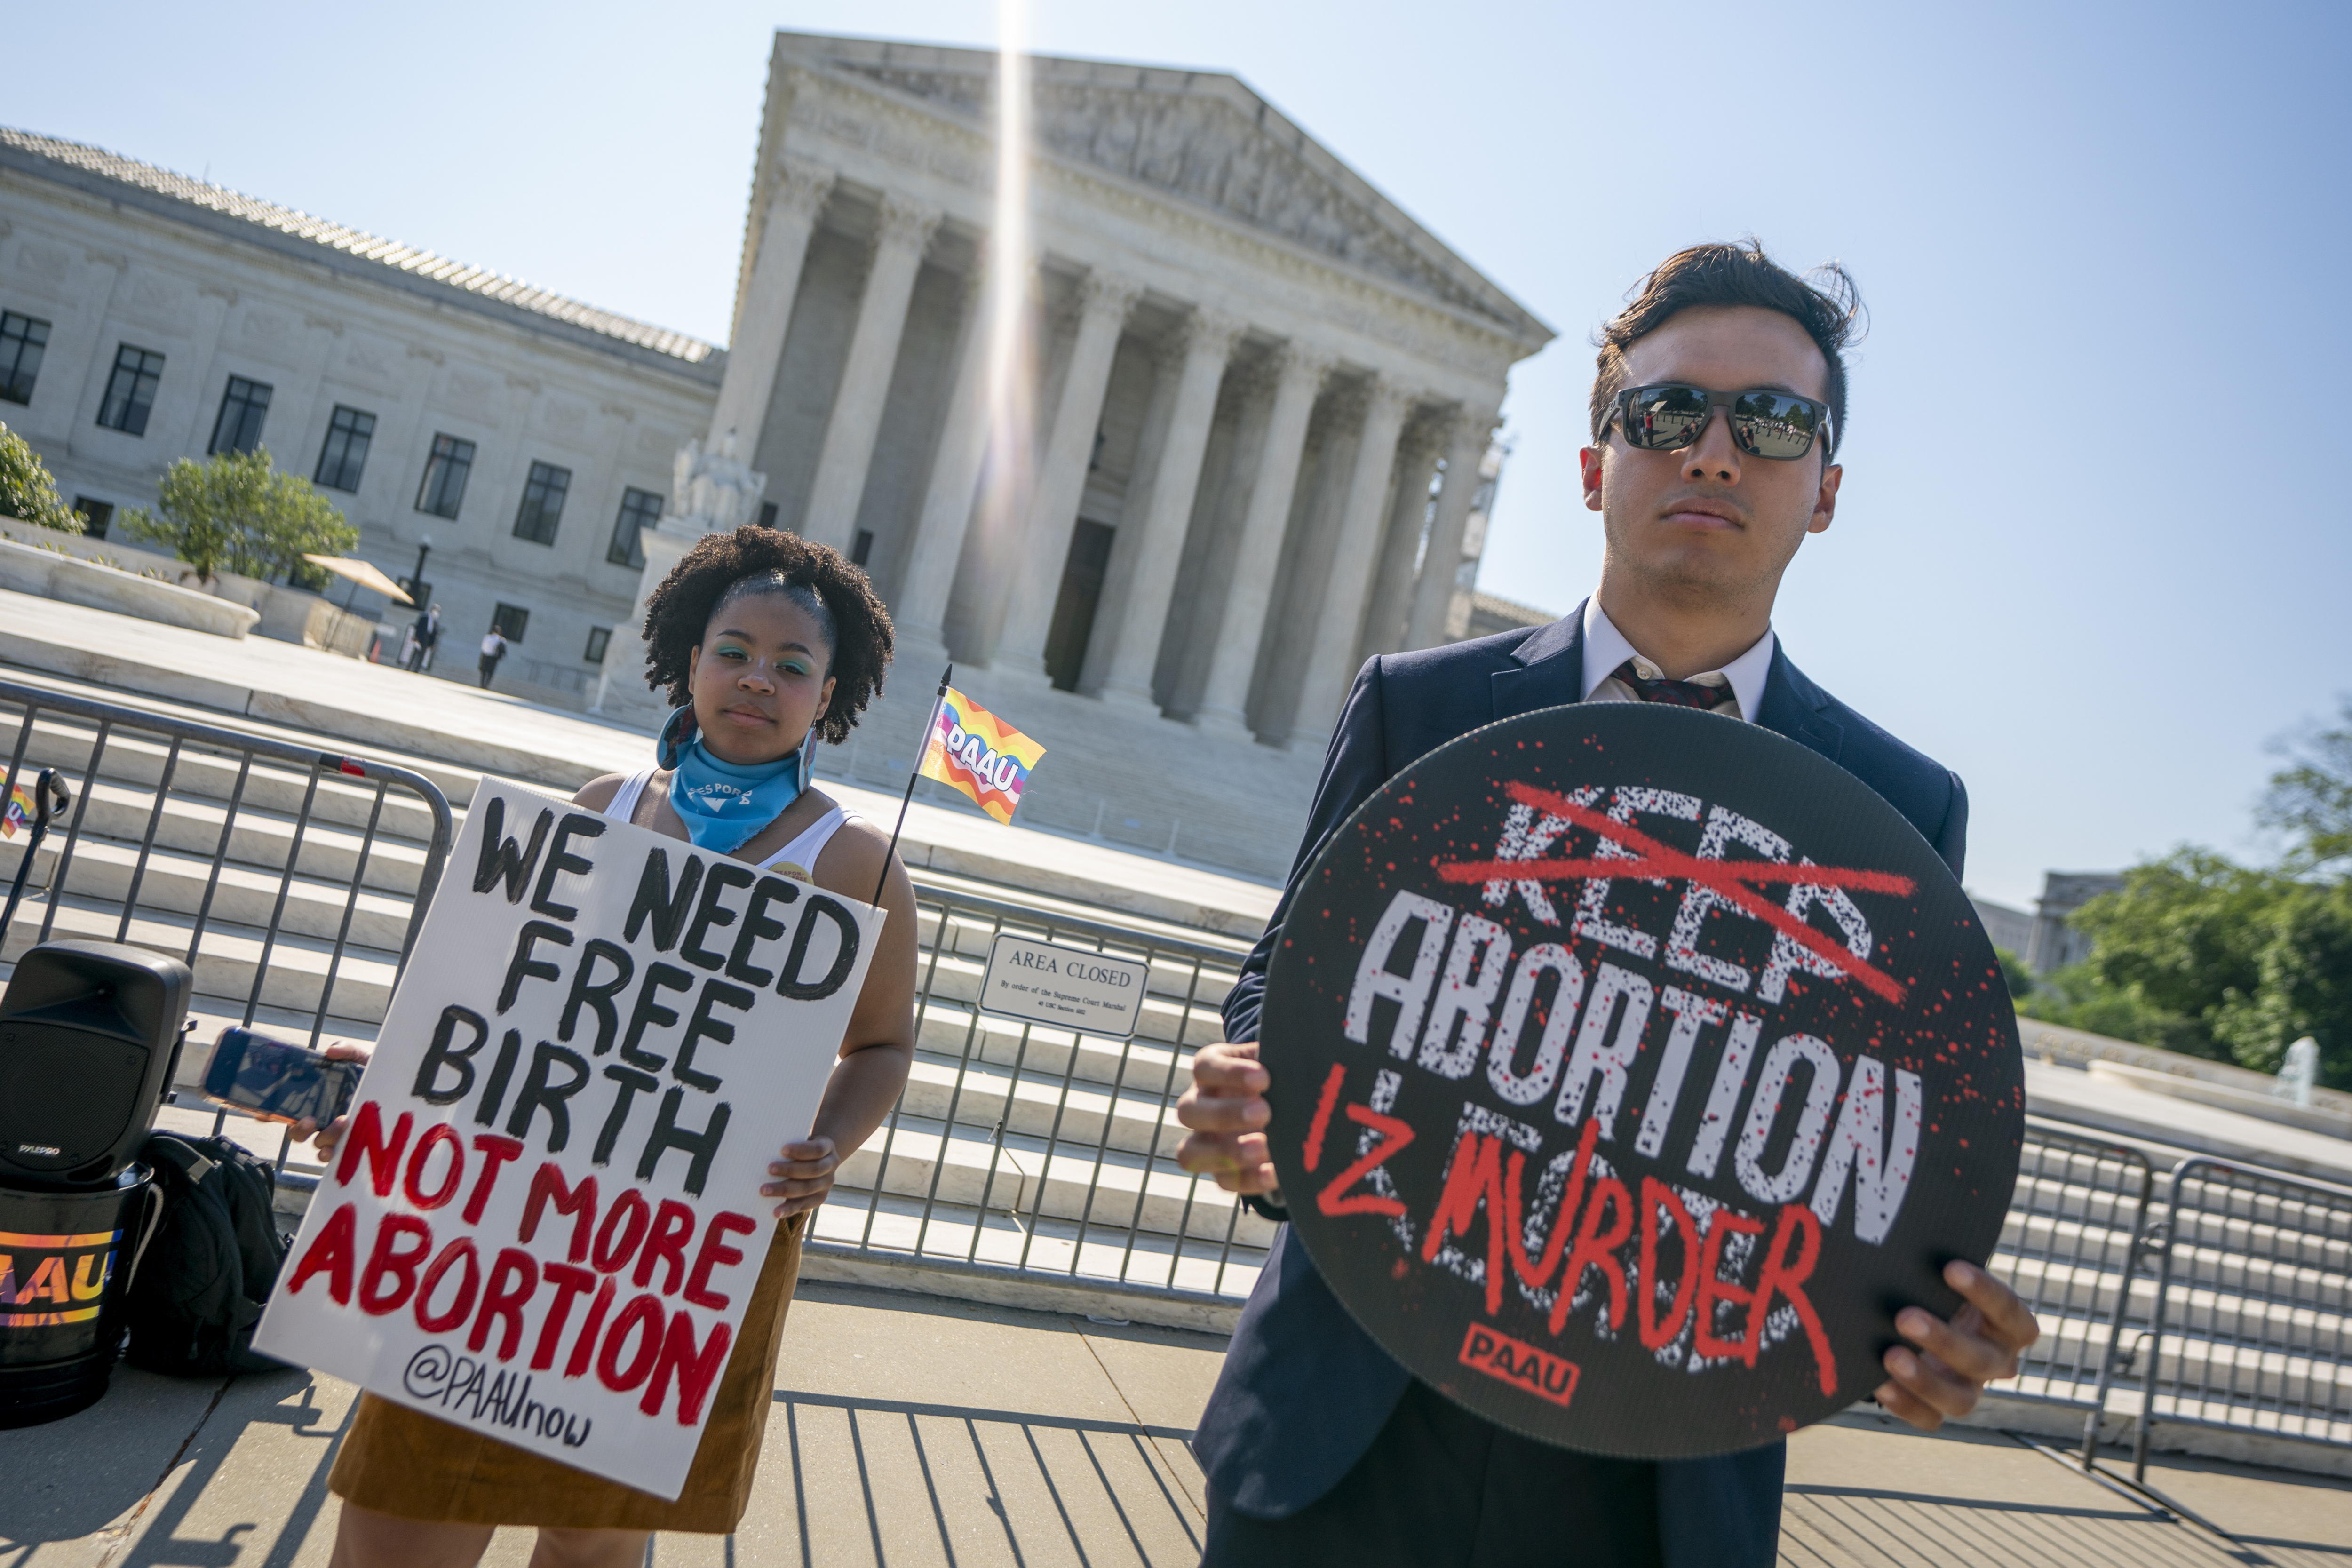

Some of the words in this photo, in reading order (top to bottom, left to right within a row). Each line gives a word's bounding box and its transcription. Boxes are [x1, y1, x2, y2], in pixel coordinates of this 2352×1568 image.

[946, 722, 1019, 791] PAAU
[473, 797, 607, 922] WE
[623, 847, 860, 1000] NEED
[1009, 950, 1057, 973] AREA
[1066, 962, 1130, 987] CLOSED
[1481, 785, 1871, 1004] KEEP
[497, 920, 755, 1092] FREE
[1001, 980, 1009, 988] By
[1053, 991, 1080, 1002] Supreme
[1082, 997, 1100, 1006] Court
[1102, 1001, 1127, 1011] Marshal
[1343, 890, 1922, 1244] ABORTION
[412, 1004, 731, 1197] BIRTH
[336, 1101, 524, 1226] NOT
[518, 1162, 756, 1310] MORE
[1304, 1063, 1415, 1218] IZ
[1422, 1117, 1837, 1397] MURDER
[288, 1202, 731, 1426] ABORTION
[404, 1344, 591, 1448] @PAAUnow
[1468, 1332, 1572, 1395] PAAU
